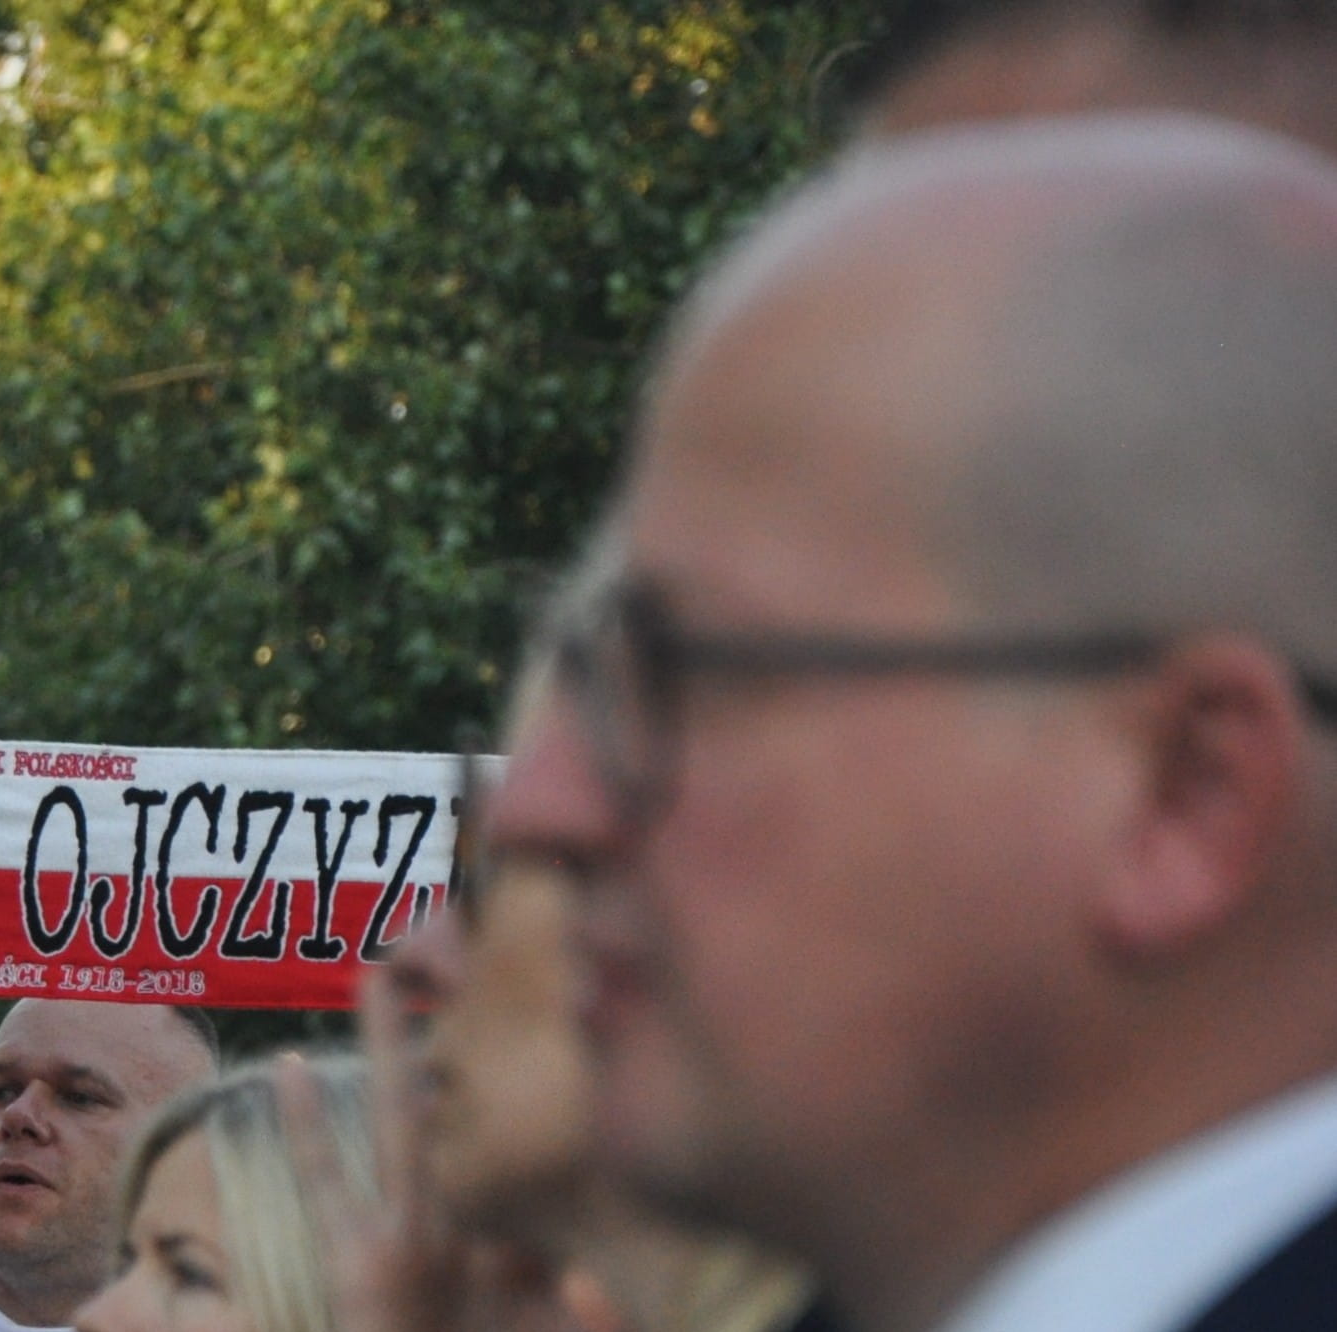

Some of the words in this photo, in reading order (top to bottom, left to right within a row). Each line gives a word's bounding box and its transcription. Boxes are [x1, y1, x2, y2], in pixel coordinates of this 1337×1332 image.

[13, 748, 137, 781] POLSKOŚCI
[25, 783, 462, 965] OJCZYZ
[58, 964, 205, 995] 1918-2018
